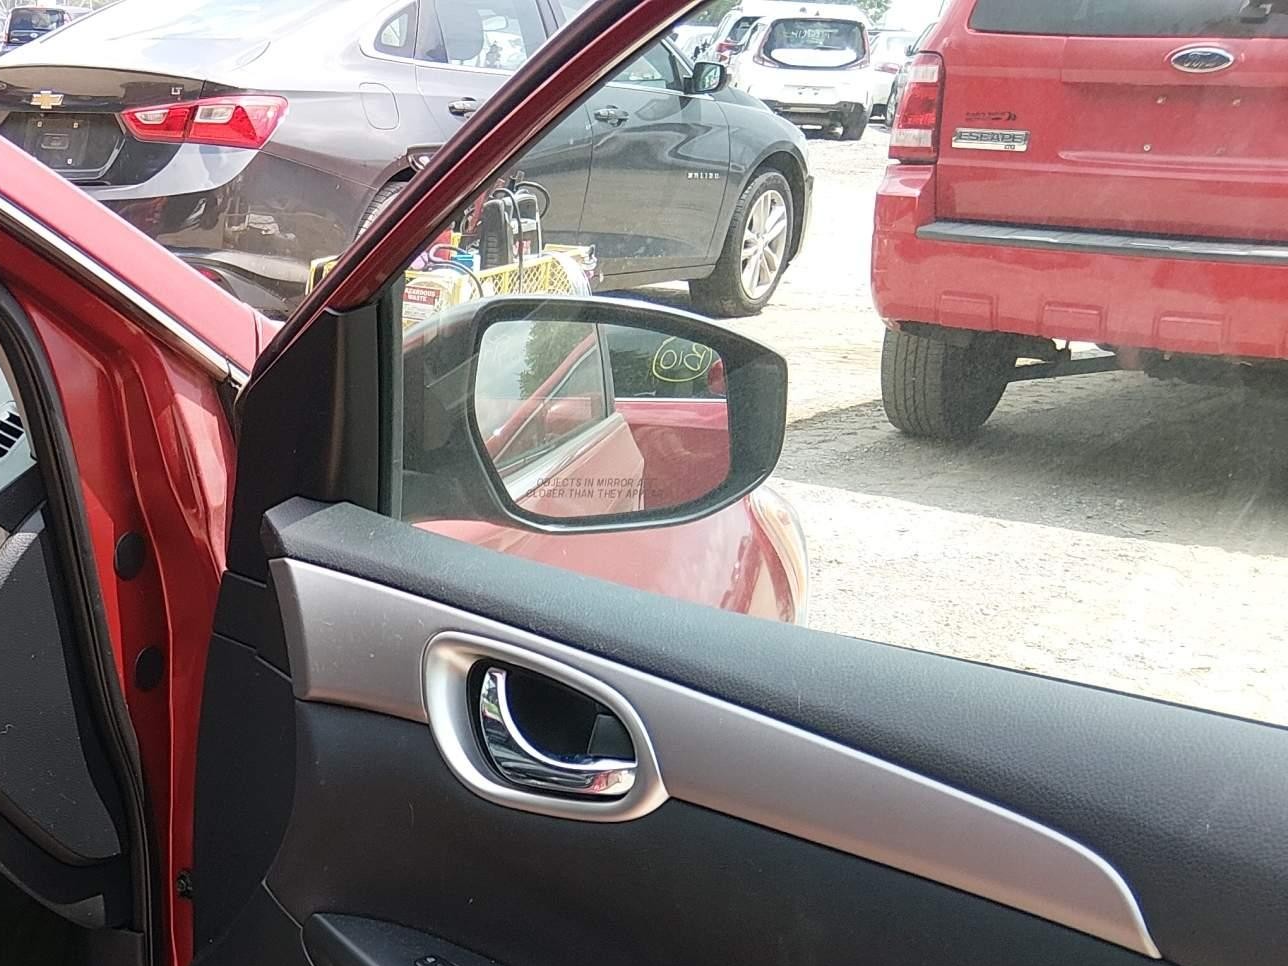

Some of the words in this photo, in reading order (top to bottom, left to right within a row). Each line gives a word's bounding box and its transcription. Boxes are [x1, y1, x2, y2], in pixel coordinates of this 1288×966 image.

[171, 87, 183, 95] LT
[957, 131, 1025, 143] ESCAPE
[536, 477, 582, 487] OBJECTS
[583, 478, 594, 487] IN
[596, 478, 633, 487] MIRROR
[569, 489, 594, 498] THAN
[597, 489, 623, 498] THEY
